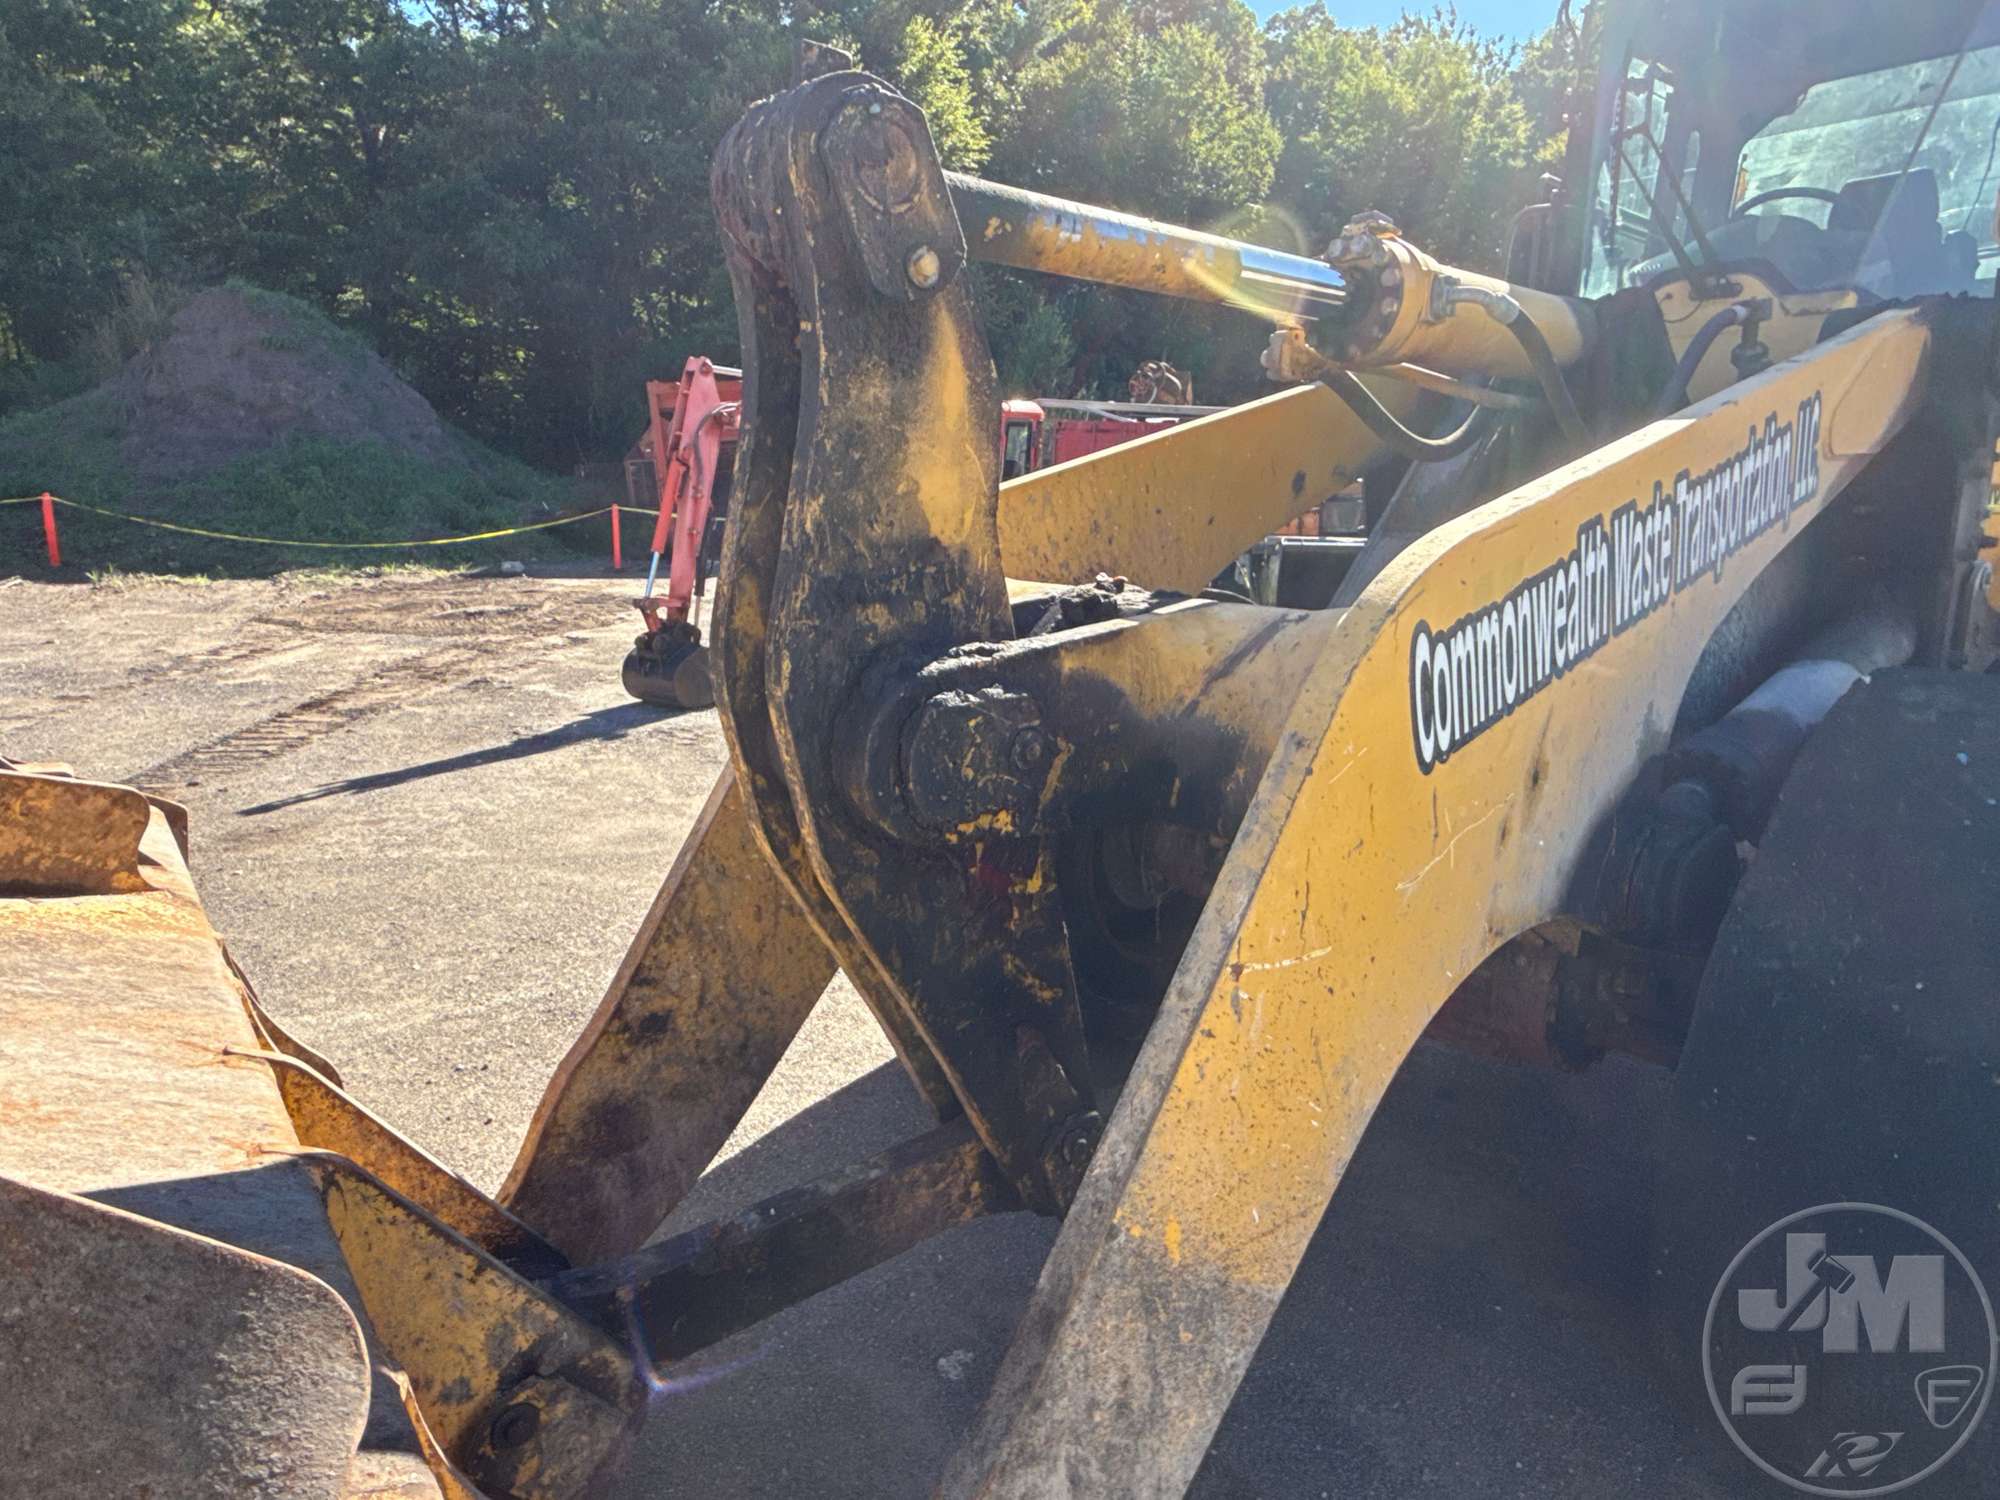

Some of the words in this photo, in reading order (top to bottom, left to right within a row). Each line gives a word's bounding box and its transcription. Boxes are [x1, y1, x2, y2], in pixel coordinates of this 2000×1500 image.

[1413, 523, 1609, 765] Commonwealth
[1613, 490, 1673, 627] Waste
[1793, 399, 1821, 501] LLC
